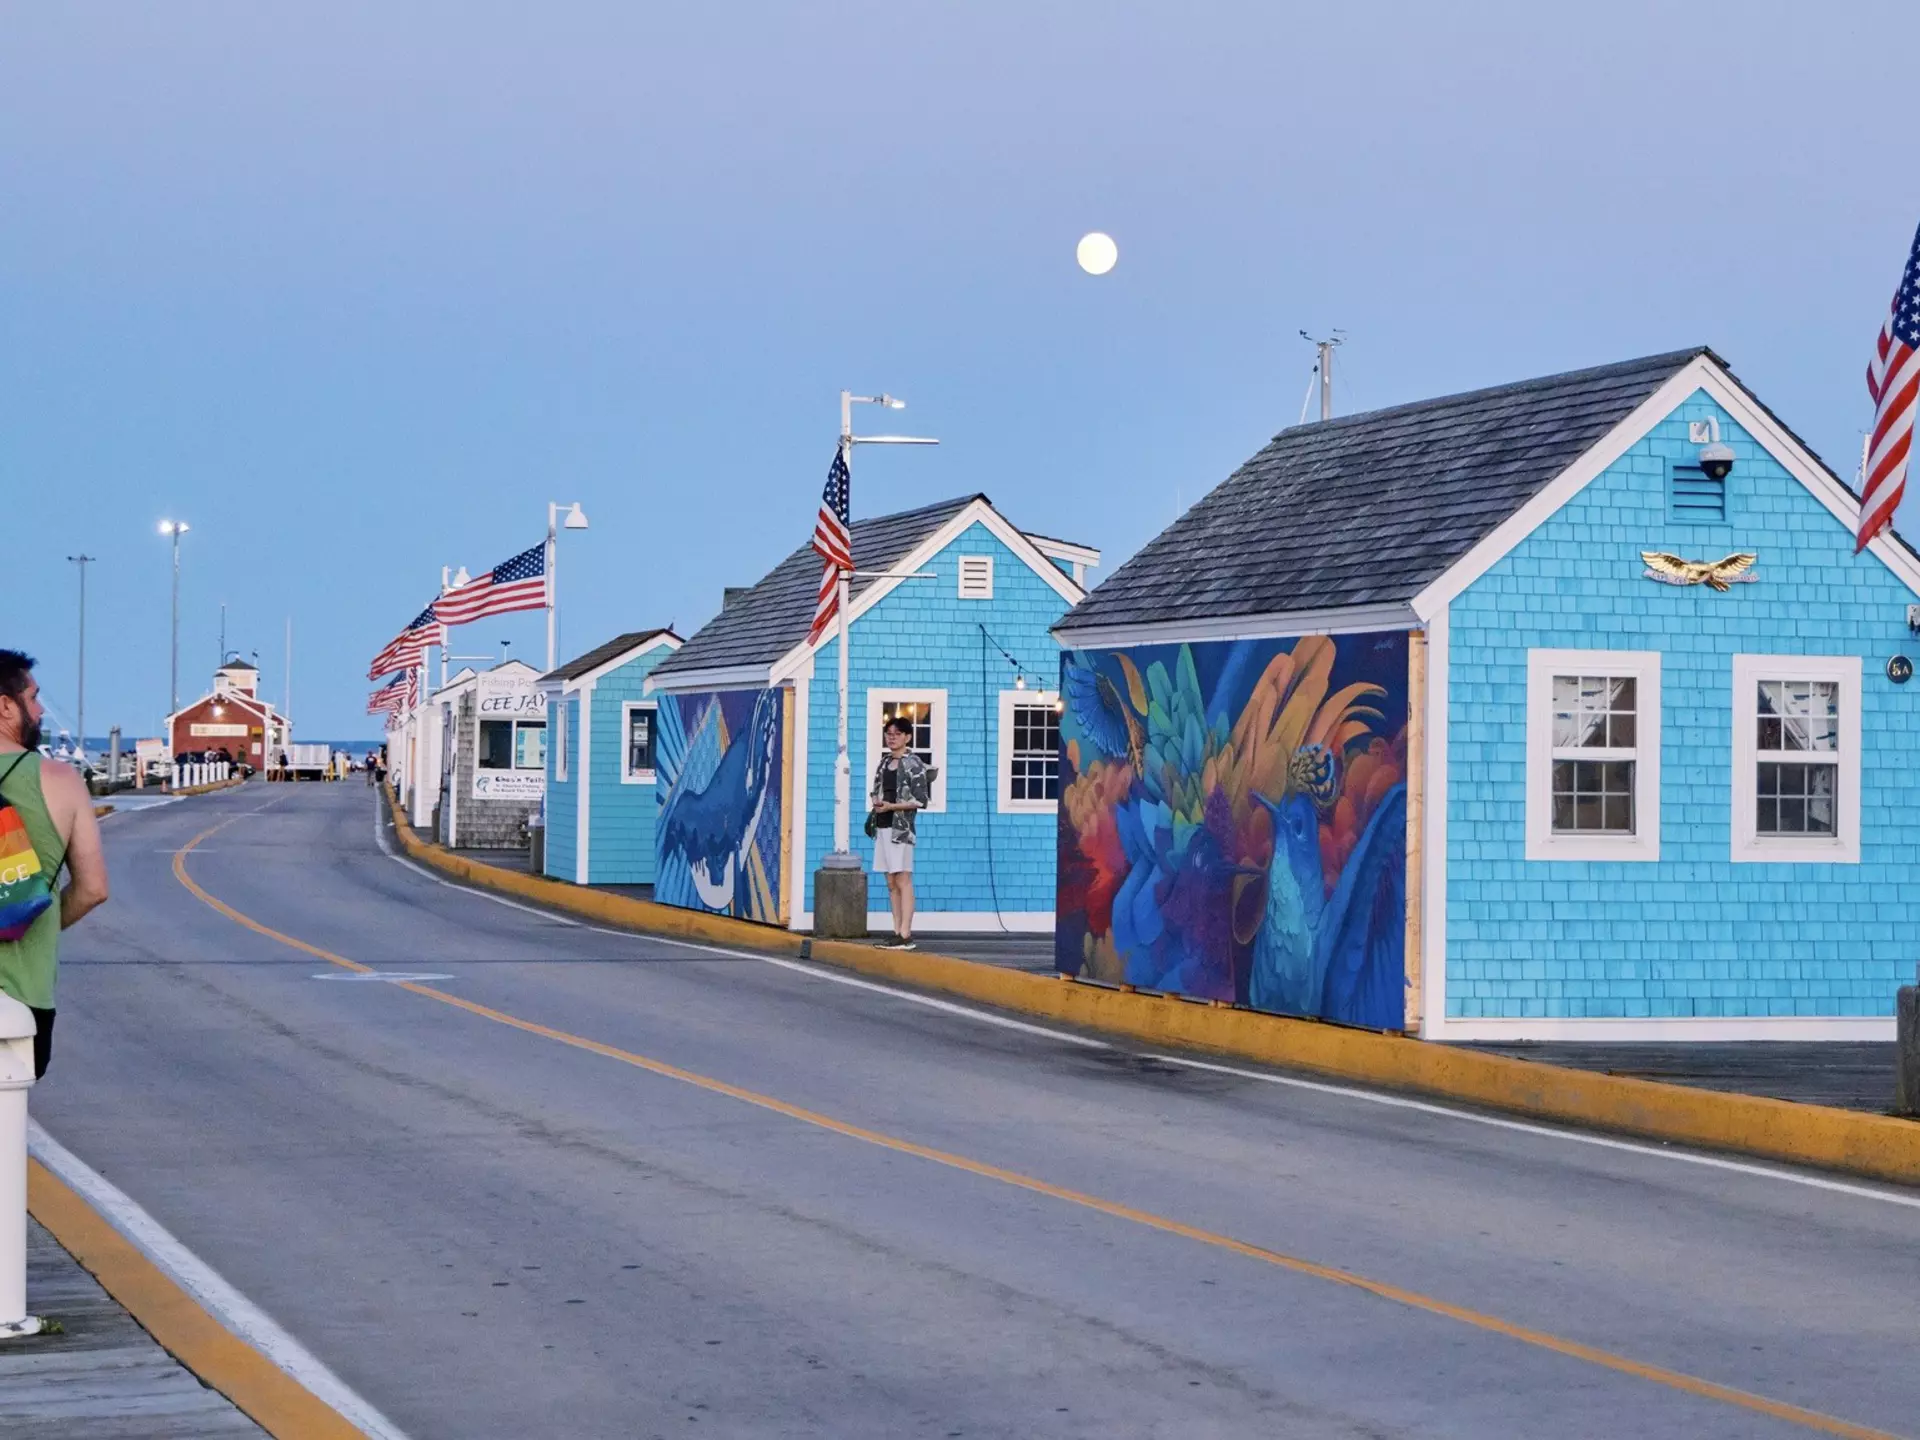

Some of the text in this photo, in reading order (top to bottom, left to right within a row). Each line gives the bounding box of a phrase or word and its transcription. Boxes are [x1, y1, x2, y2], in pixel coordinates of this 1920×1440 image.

[1892, 662, 1909, 677] 5A
[481, 676, 516, 689] Fishing
[481, 693, 548, 711] CEE JAY
[0, 863, 31, 885] CE
